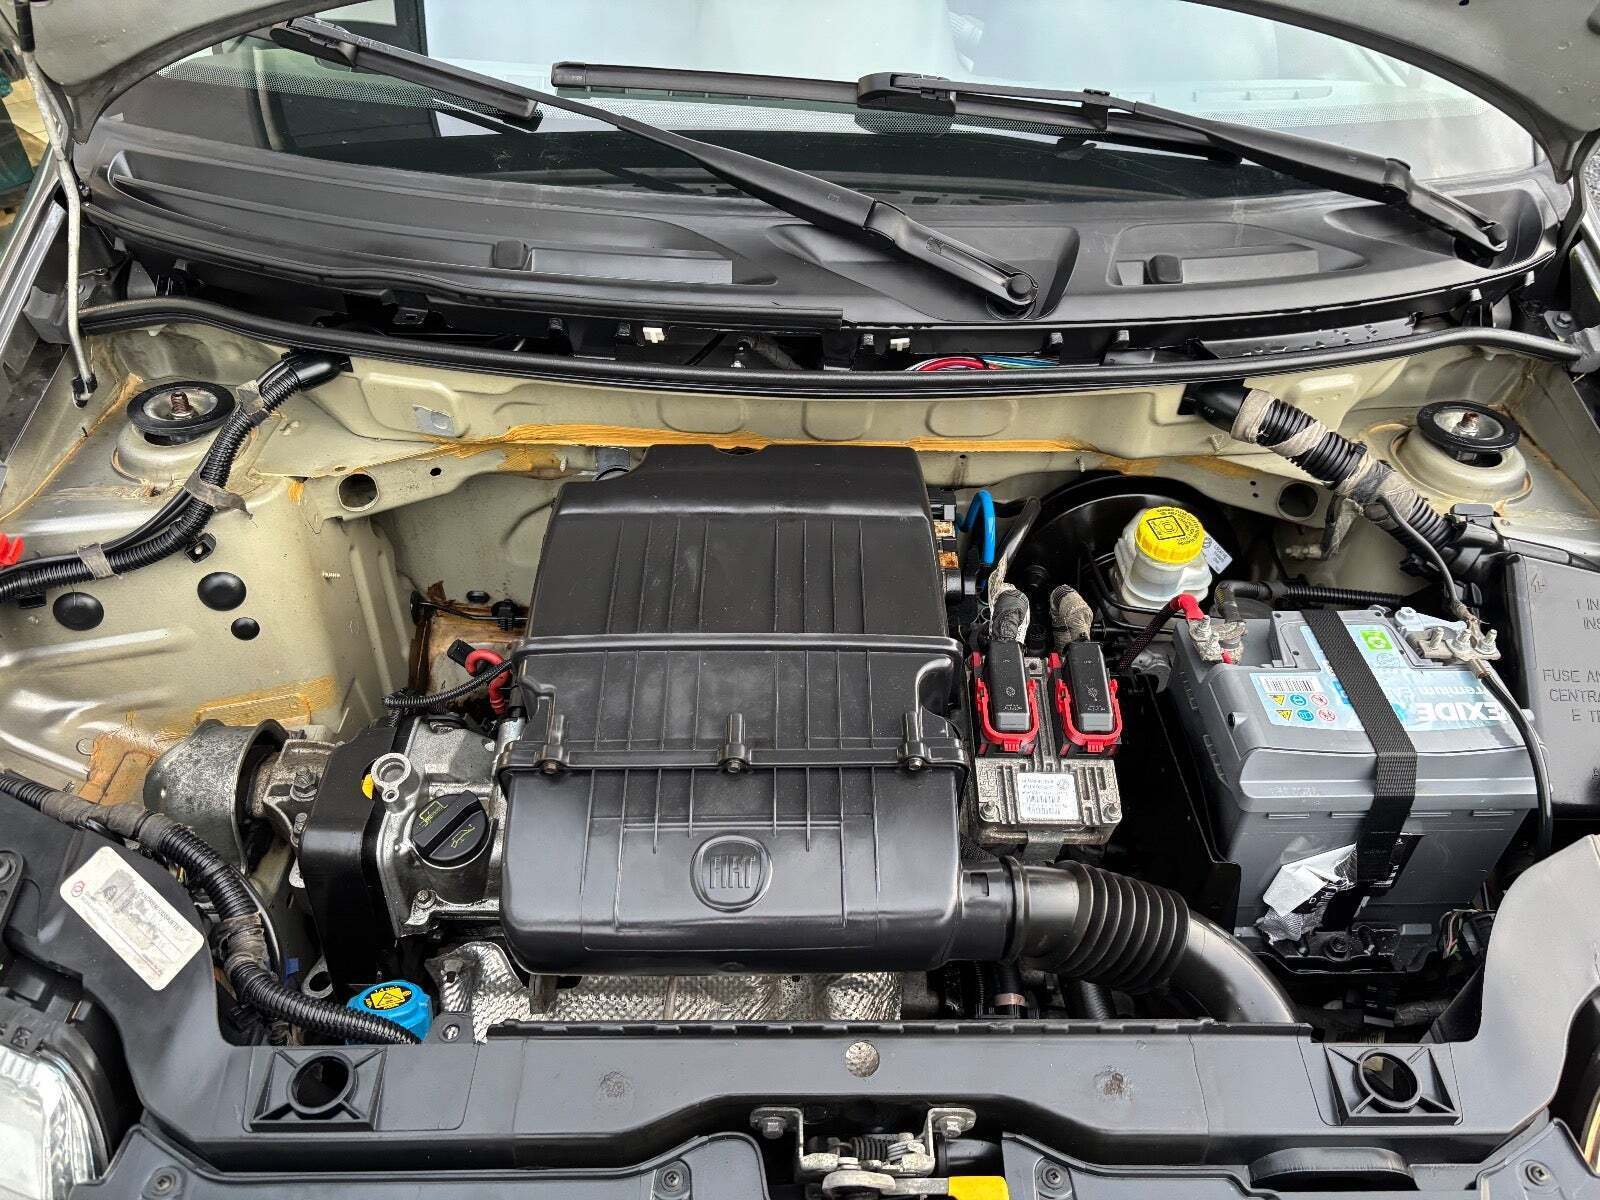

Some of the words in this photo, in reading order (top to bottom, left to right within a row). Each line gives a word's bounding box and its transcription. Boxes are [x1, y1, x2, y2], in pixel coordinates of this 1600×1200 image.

[1542, 668, 1581, 684] FUSE
[1414, 701, 1508, 722] EXIDE
[710, 856, 755, 889] FIAT
